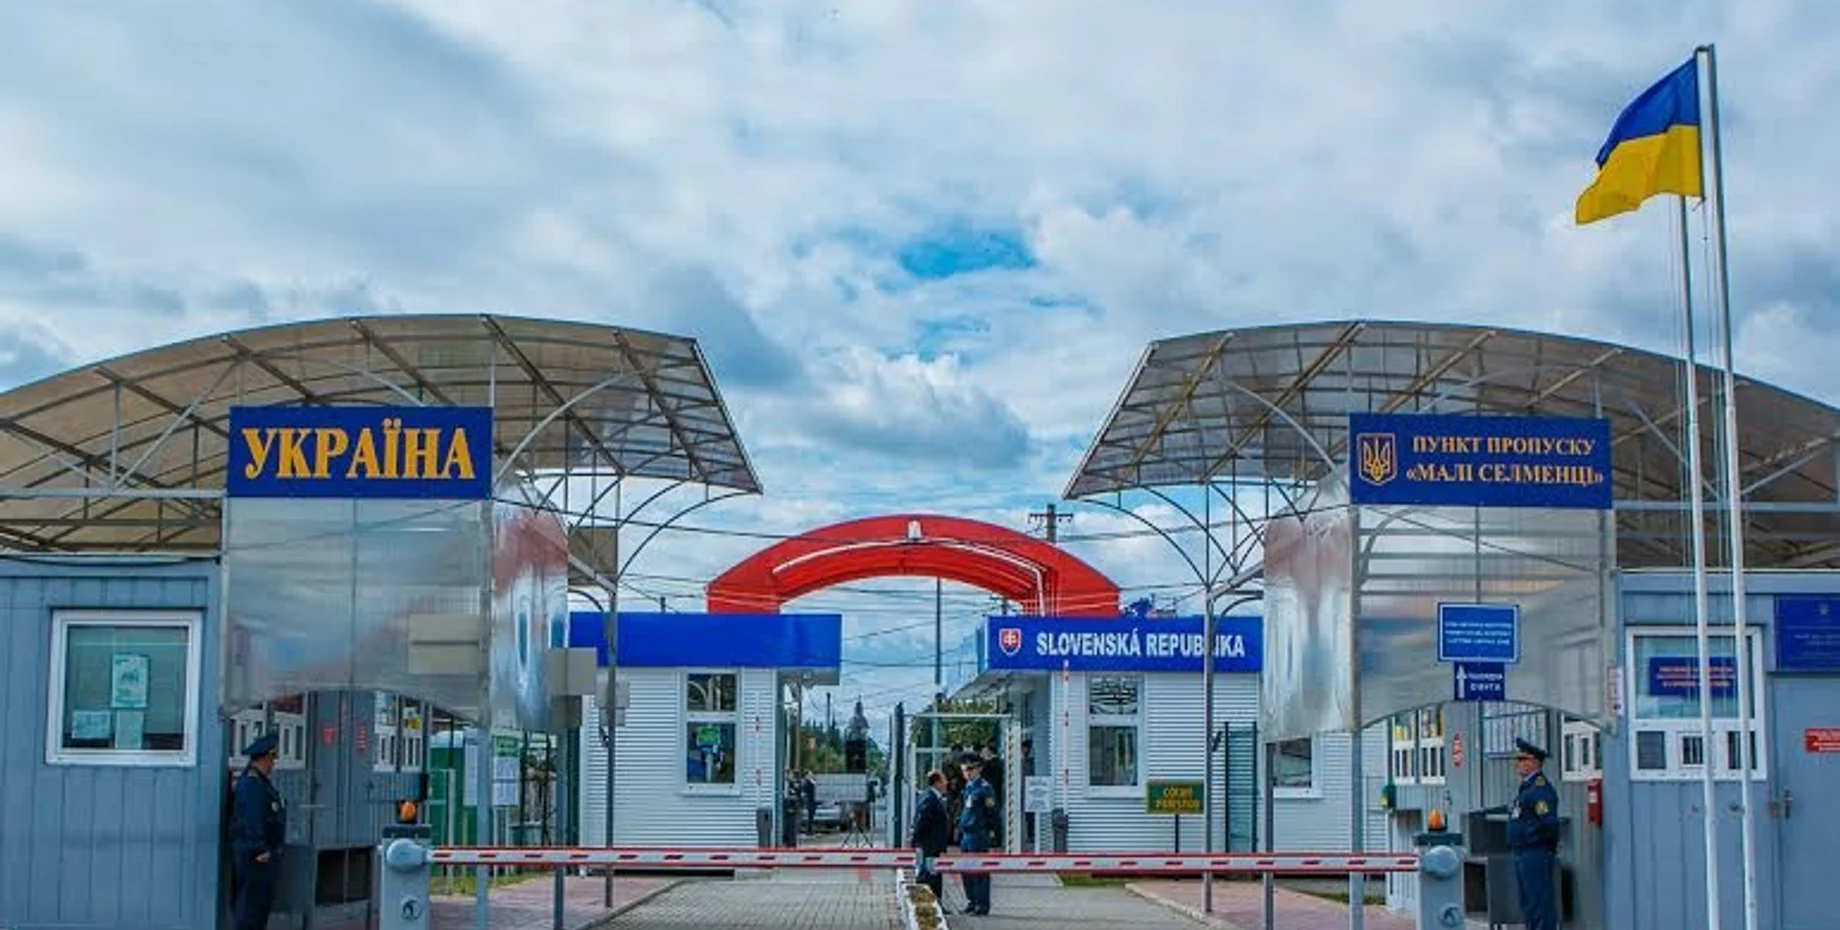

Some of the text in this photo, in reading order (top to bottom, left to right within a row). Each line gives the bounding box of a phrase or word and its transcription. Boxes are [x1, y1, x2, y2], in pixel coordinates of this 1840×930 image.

[241, 418, 476, 479] УКРАЇНА
[1412, 435, 1596, 456] ПУНКТ ПРОПУСКУ
[1406, 463, 1604, 487] «МАЛІ СЕЛМЕНЦІ»
[1036, 628, 1246, 657] SLOVENSKÁ REPUBIKA
